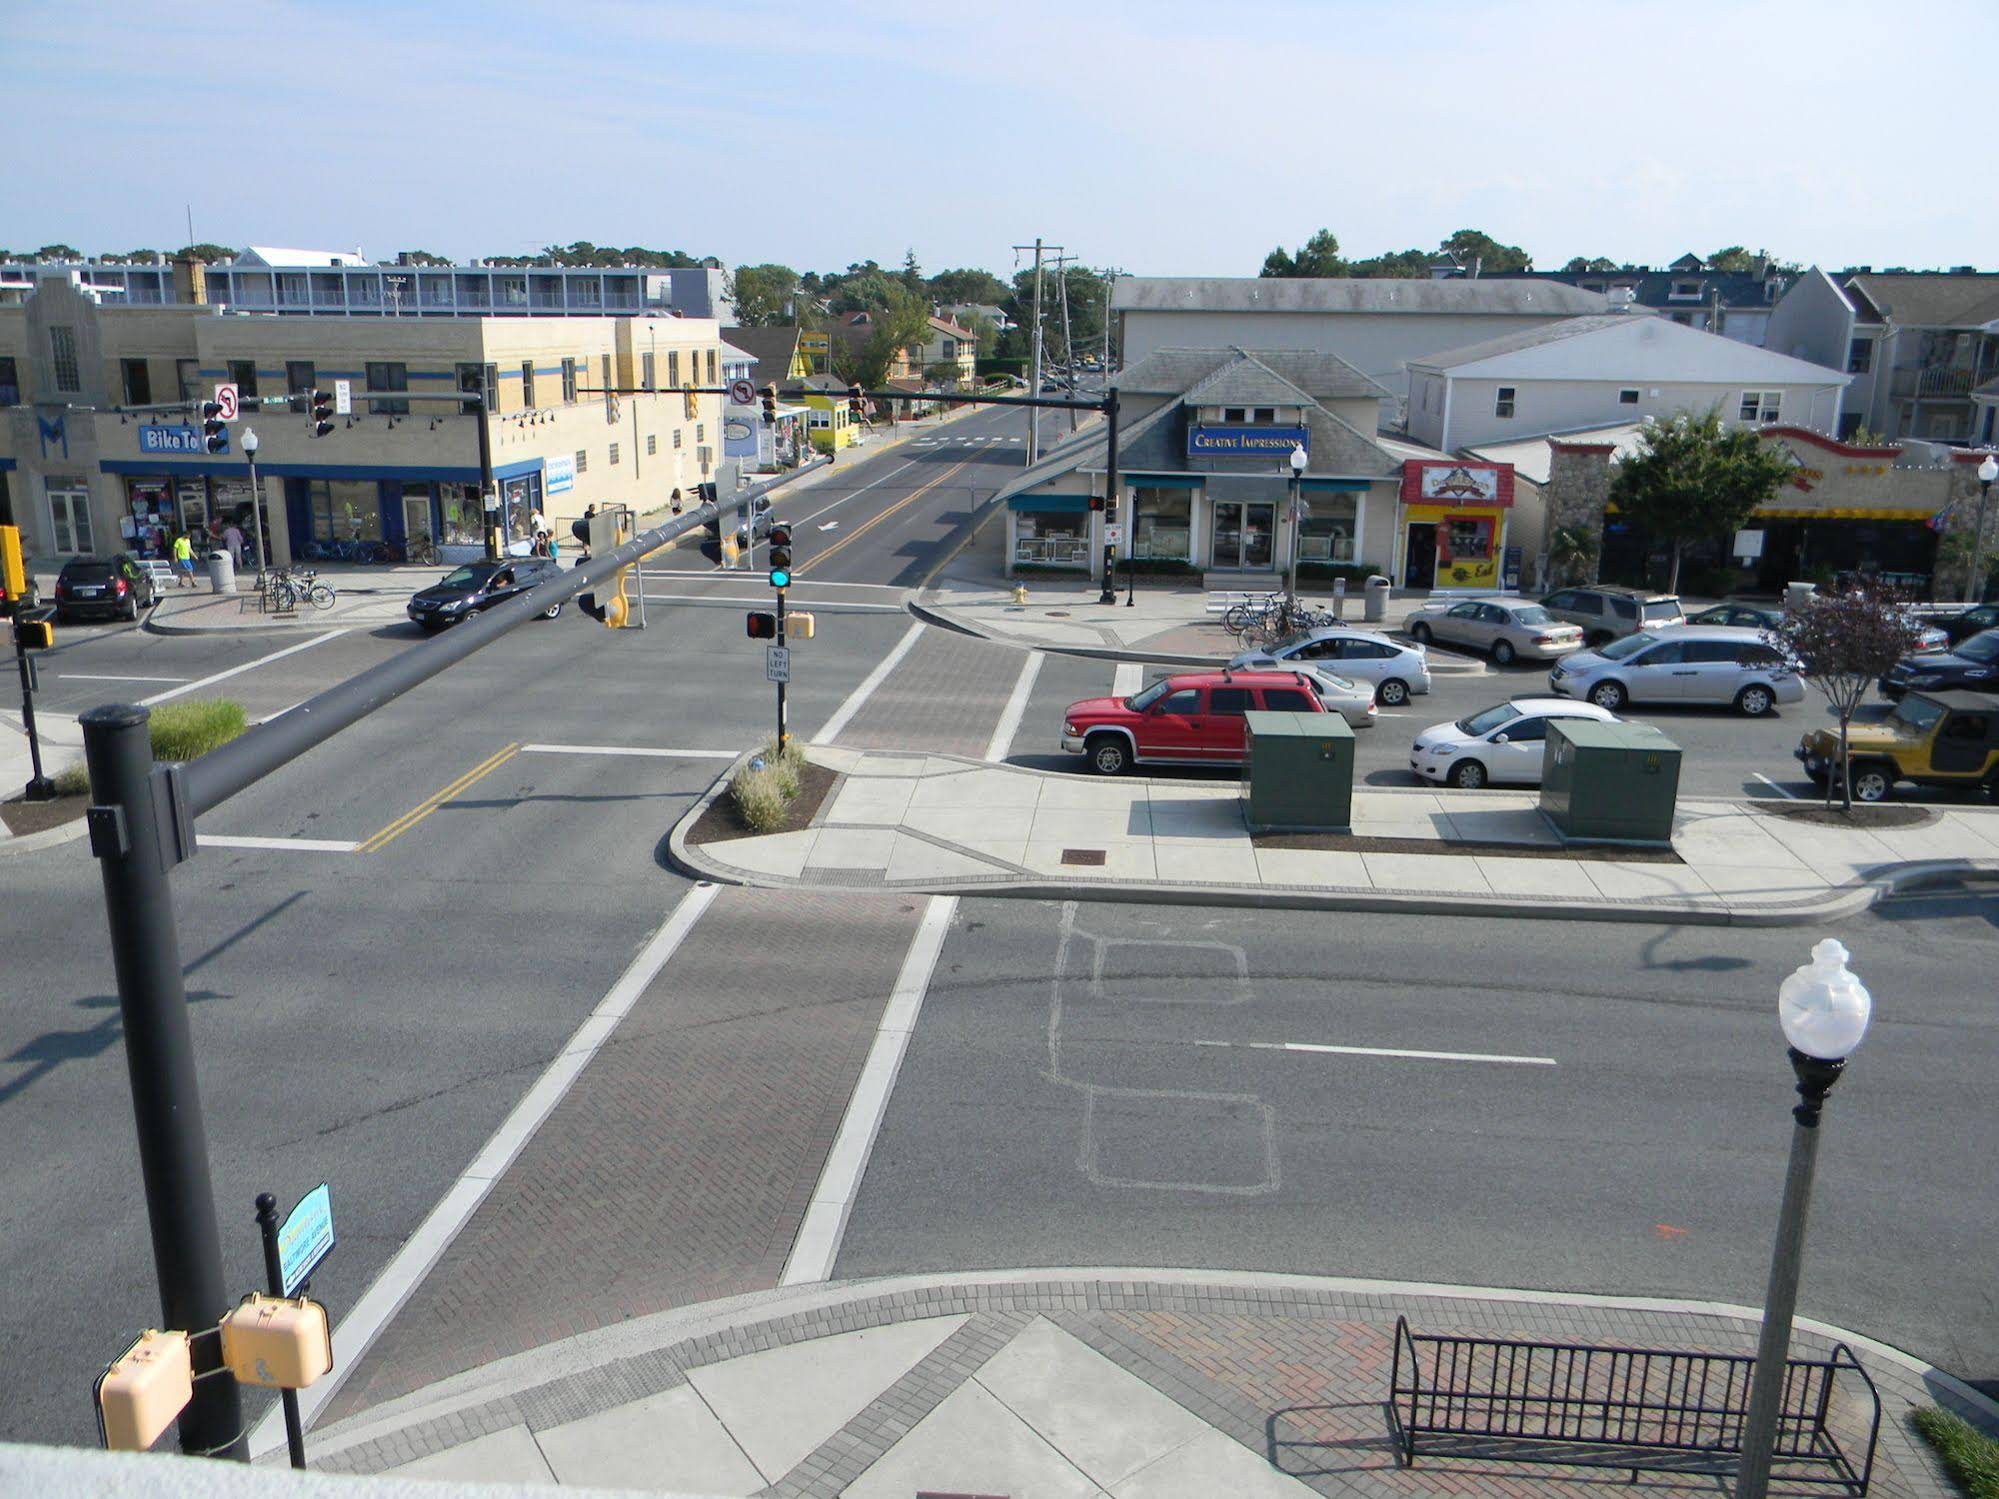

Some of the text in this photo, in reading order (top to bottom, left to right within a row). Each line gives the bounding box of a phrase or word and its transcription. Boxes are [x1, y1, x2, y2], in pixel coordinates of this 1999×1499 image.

[147, 429, 180, 449] Bike
[1195, 434, 1302, 448] CREATIVE IMPRESSIONS
[770, 660, 786, 668] LEFT
[770, 669, 788, 678] TURN
